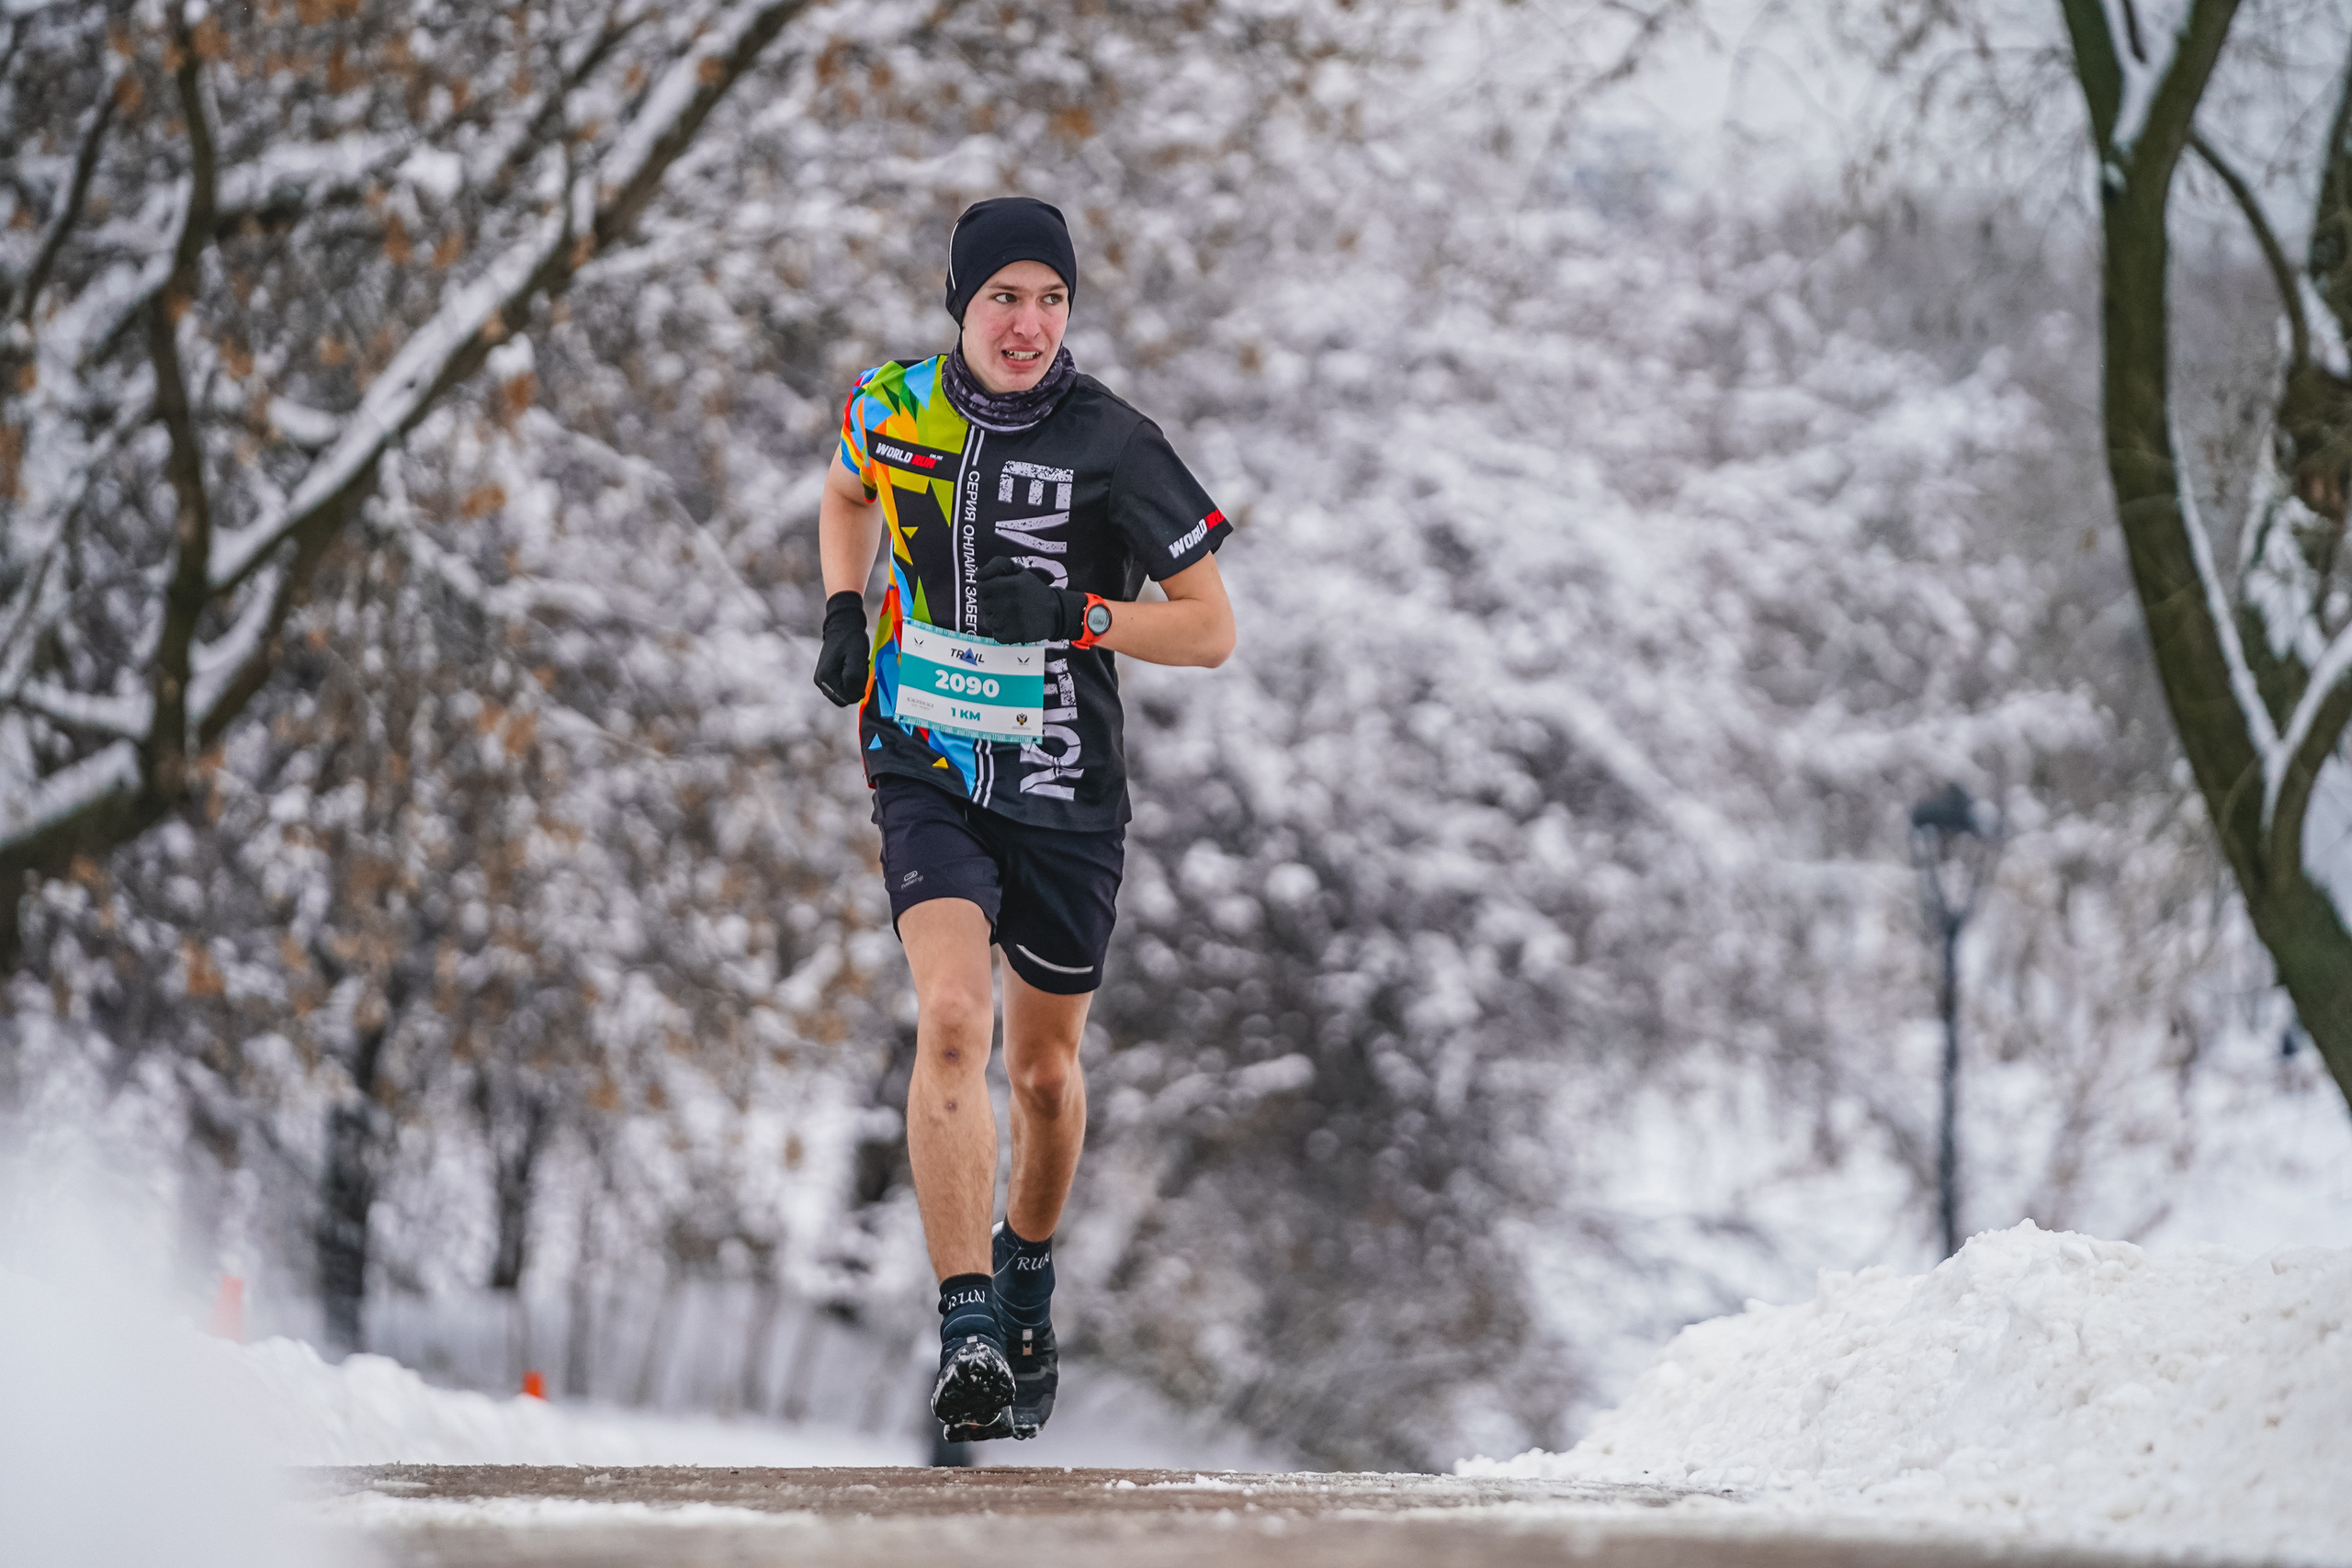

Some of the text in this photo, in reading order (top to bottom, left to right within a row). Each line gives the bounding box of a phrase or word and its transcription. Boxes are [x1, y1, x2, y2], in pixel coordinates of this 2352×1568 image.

[876, 442, 913, 464] WORLD
[911, 454, 937, 469] RUN
[965, 470, 980, 522] СЕРИЯ
[1168, 518, 1208, 558] WORLD
[963, 524, 978, 583] ОНЛАЙН
[934, 669, 1001, 698] 2090
[950, 706, 956, 717] 1
[1016, 1250, 1051, 1270] RUN
[947, 1289, 986, 1311] RUN
